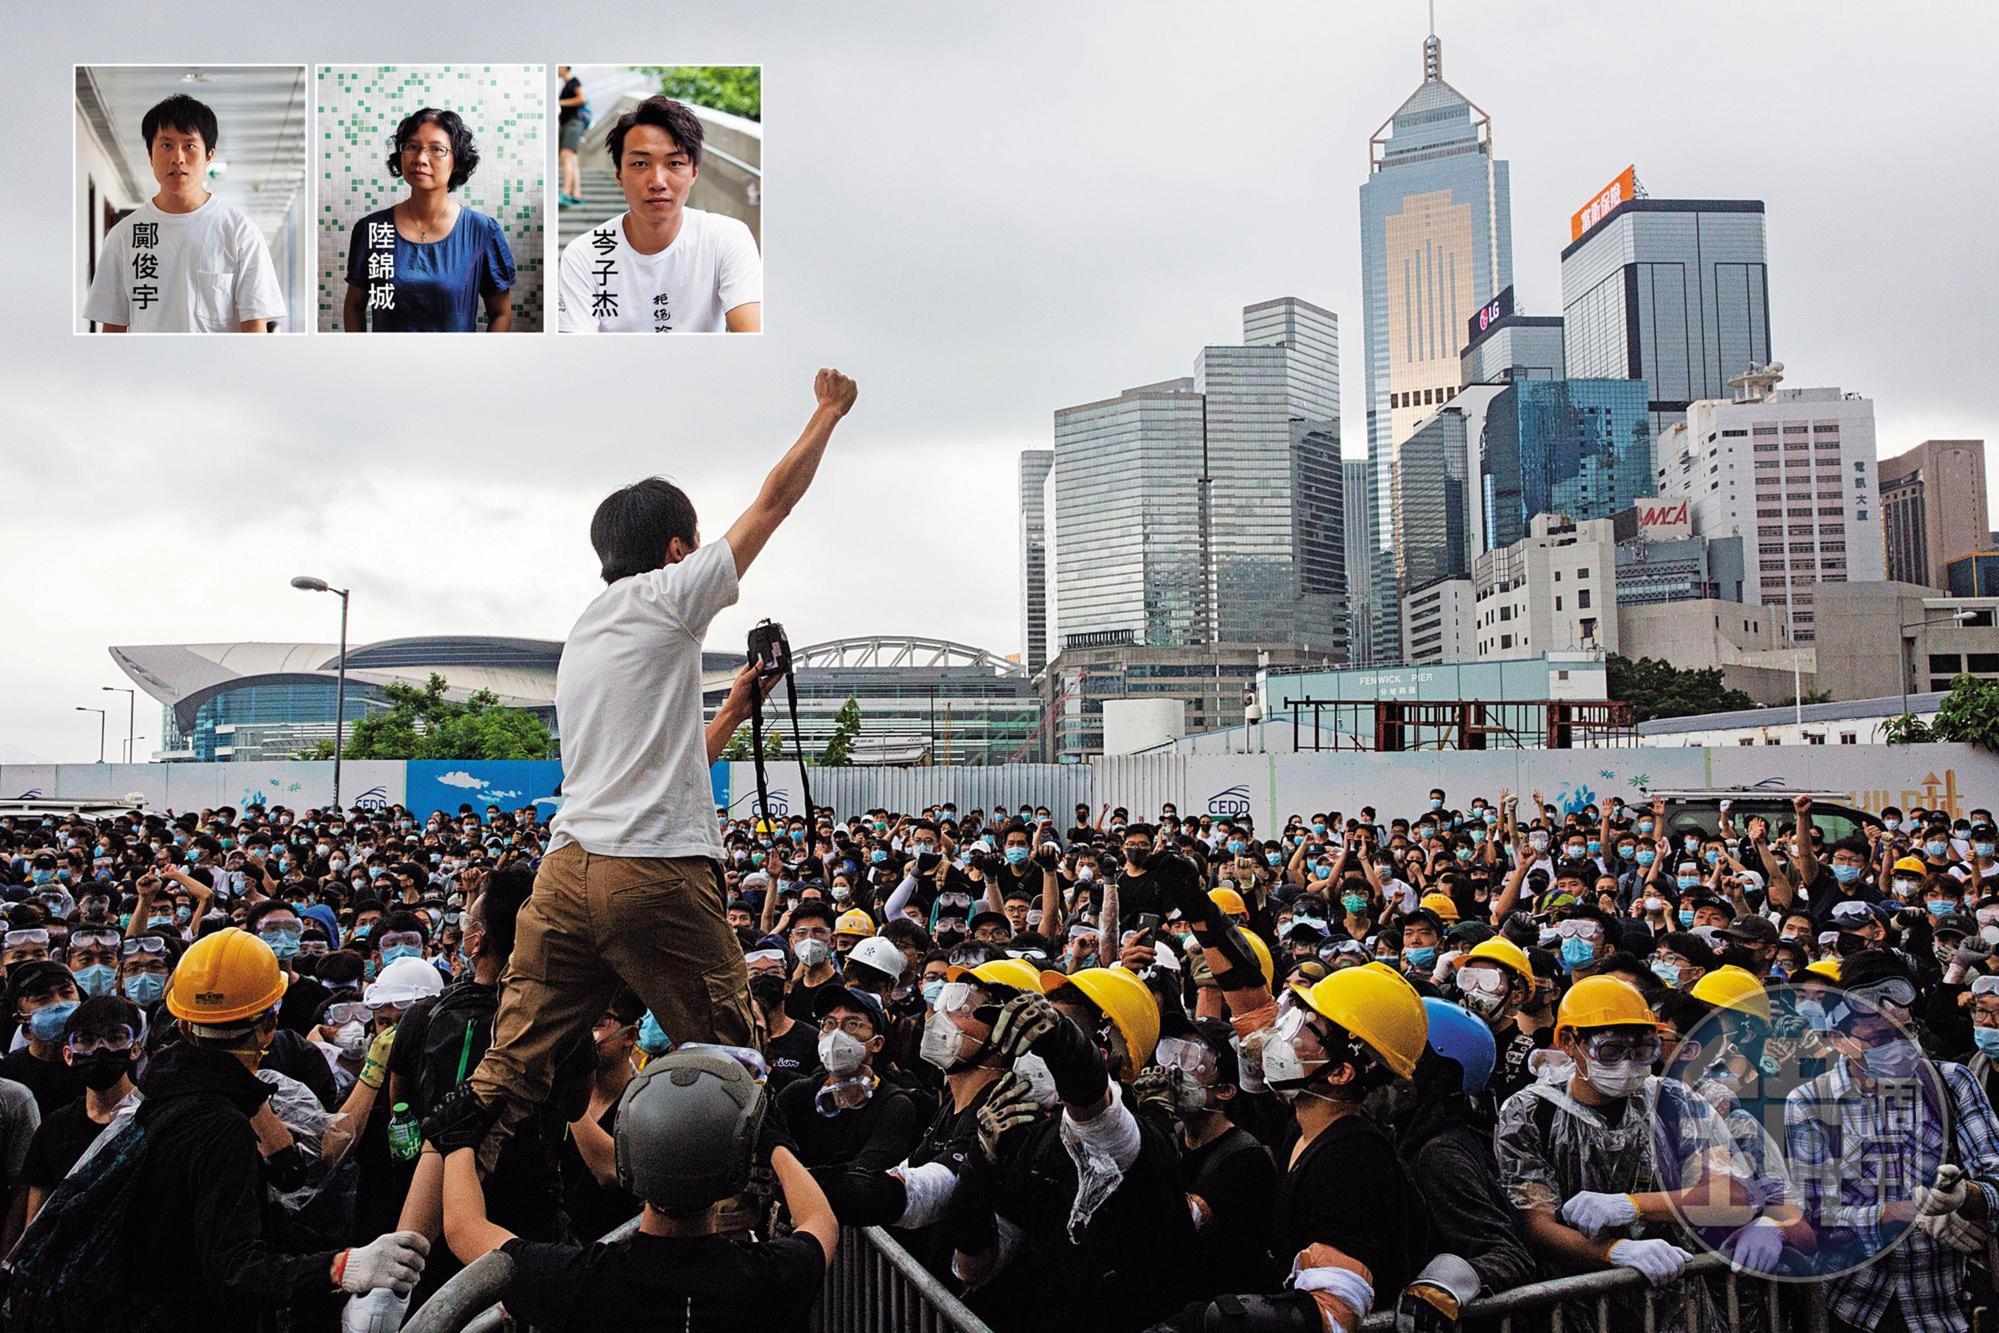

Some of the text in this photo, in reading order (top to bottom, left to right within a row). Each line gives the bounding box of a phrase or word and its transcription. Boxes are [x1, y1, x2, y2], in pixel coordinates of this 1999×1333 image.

[1488, 301, 1500, 323] LG
[1360, 673, 1433, 686] FENWICK PIER
[752, 803, 788, 816] CDD
[1208, 800, 1250, 815] CEDD
